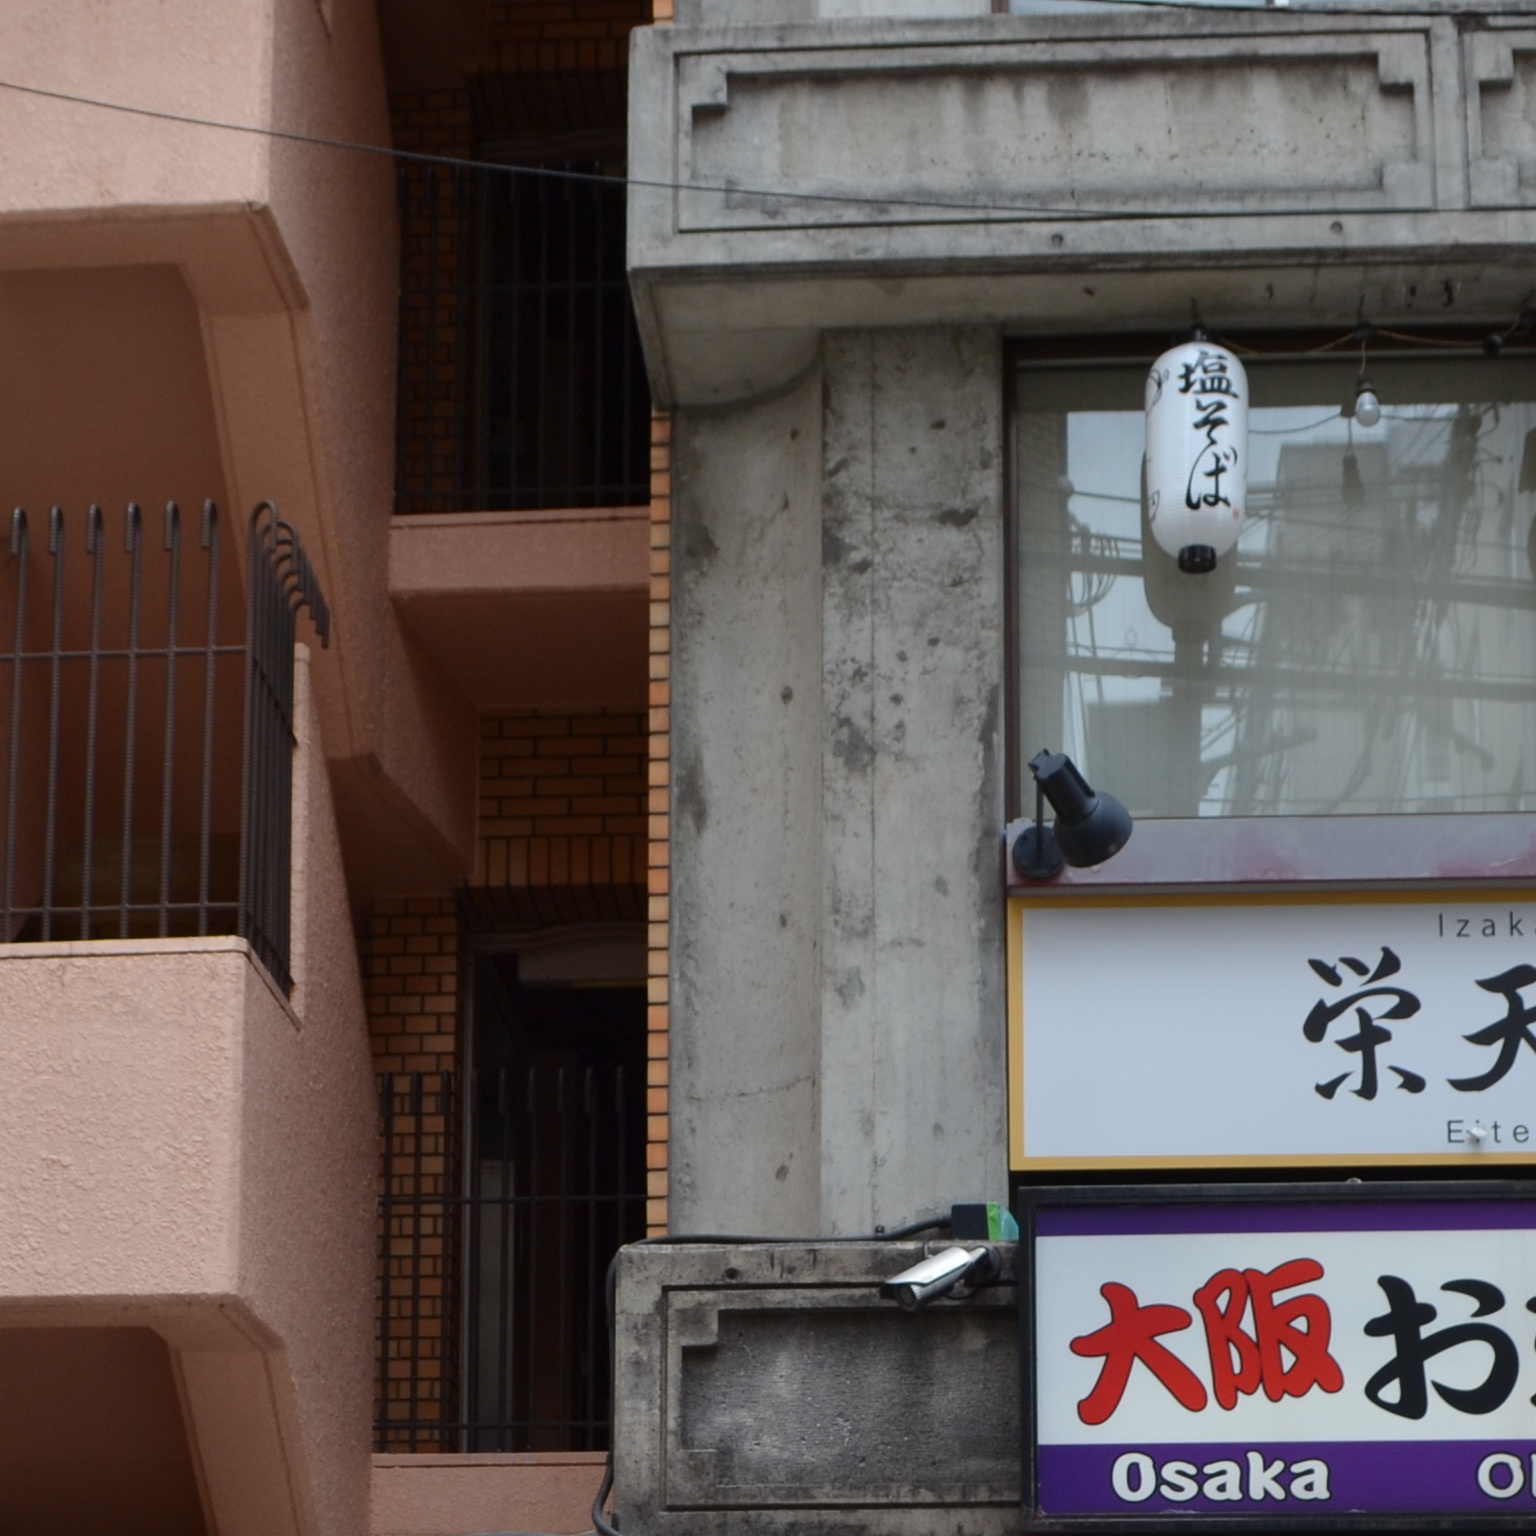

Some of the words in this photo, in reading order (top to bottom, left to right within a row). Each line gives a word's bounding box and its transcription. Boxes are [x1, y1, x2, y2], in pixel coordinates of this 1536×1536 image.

[1177, 350, 1240, 512] 塩そば
[1069, 1256, 1346, 1428] 大阪
[1109, 1449, 1332, 1506] Osaka
